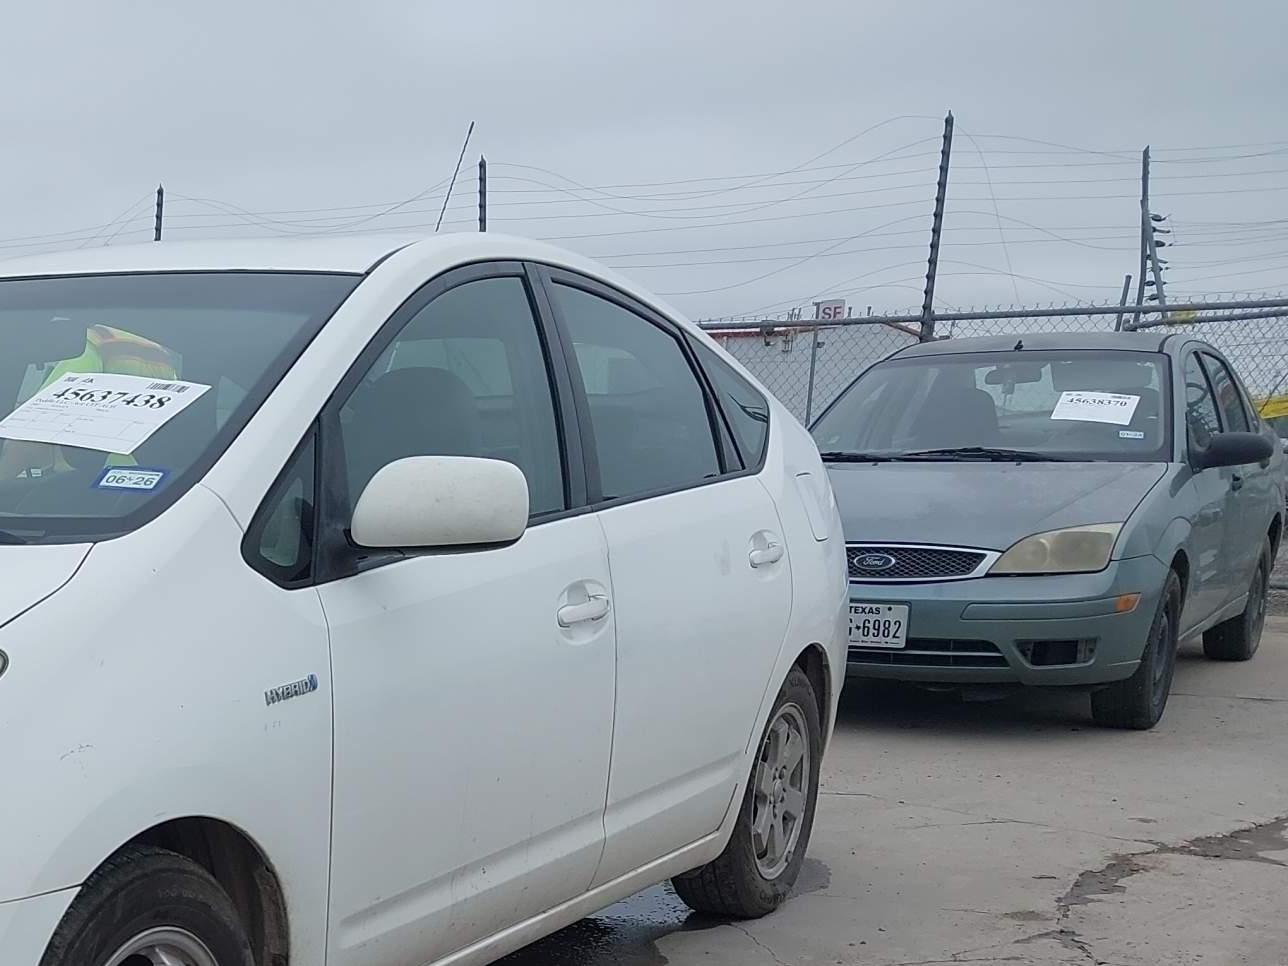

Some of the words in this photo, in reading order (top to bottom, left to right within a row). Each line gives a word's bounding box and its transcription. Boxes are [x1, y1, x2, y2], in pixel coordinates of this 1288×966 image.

[53, 387, 172, 410] 45637438
[1067, 397, 1128, 407] 45638370
[862, 556, 885, 566] Ford
[849, 605, 881, 615] TEXAS
[264, 678, 312, 706] HYBRID
